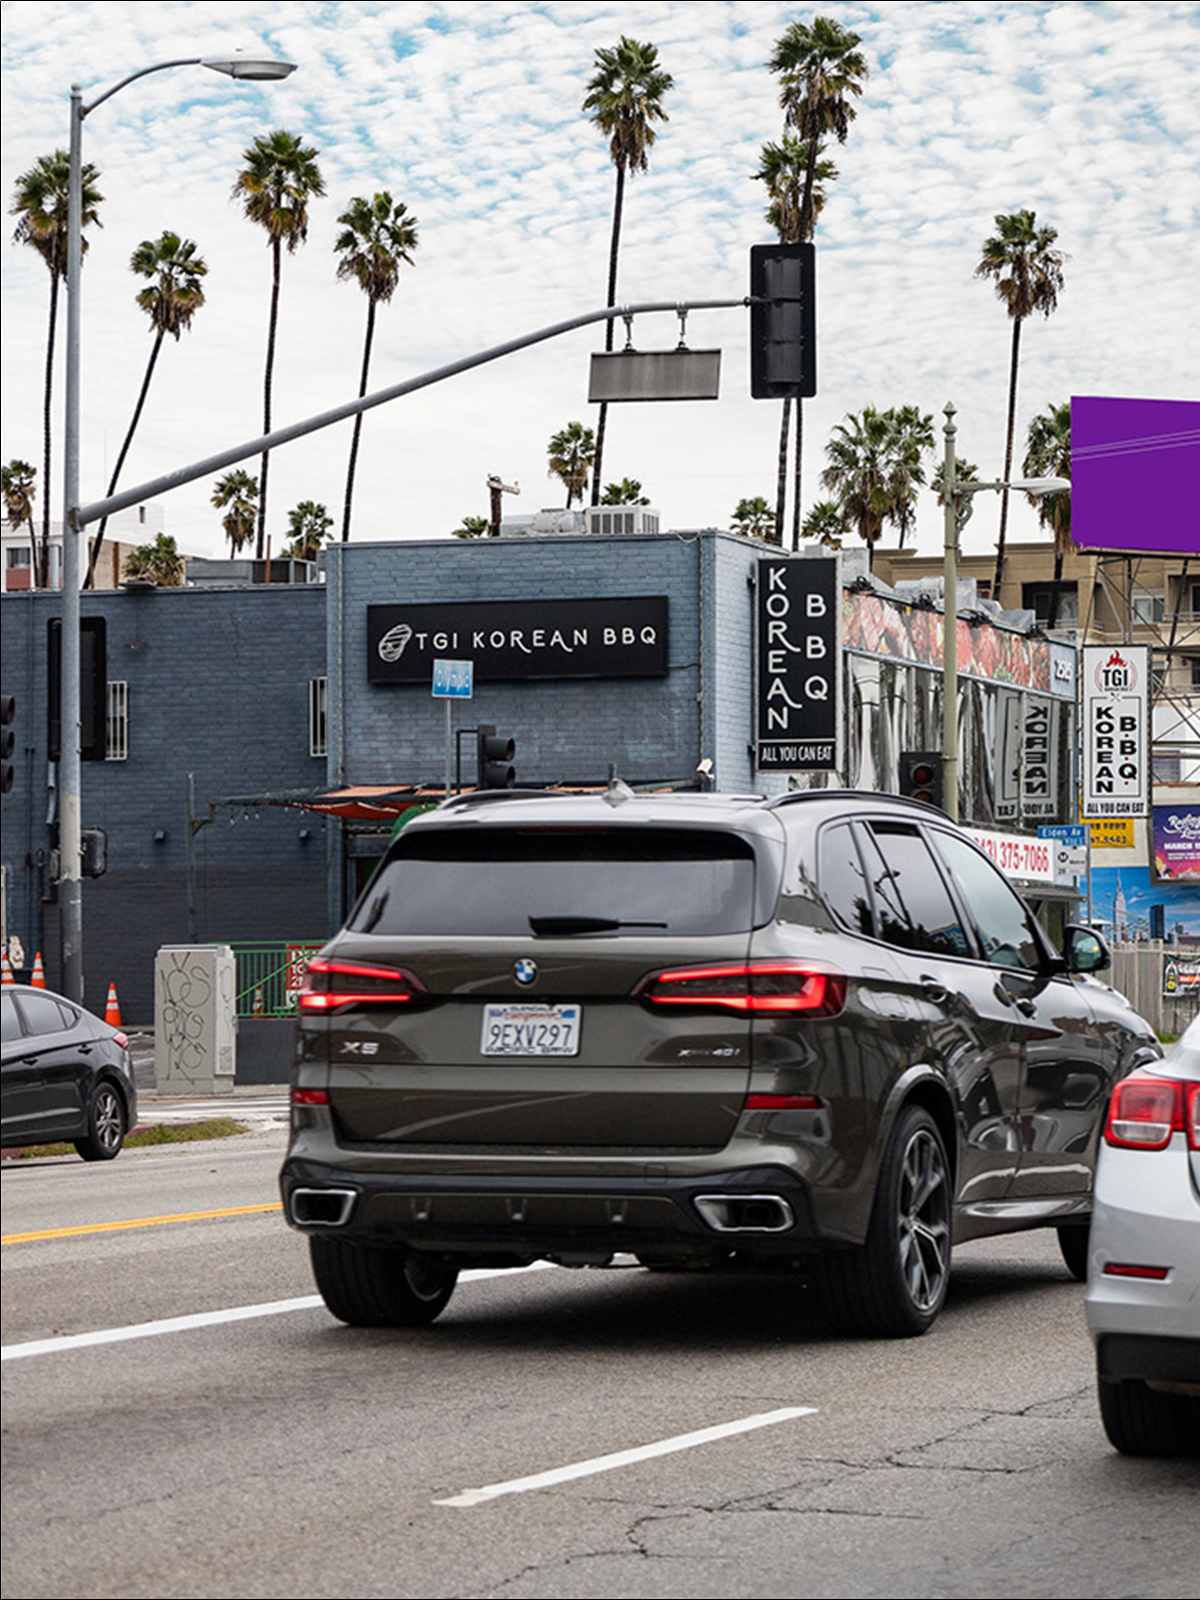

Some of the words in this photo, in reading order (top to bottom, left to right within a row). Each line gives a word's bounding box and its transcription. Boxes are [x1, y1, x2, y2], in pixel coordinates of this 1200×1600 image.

[416, 631, 459, 652] TGI
[473, 628, 588, 654] KOREAN
[604, 626, 657, 646] BBQ
[766, 567, 802, 730] KOREAN
[804, 594, 828, 701] BBQ
[1102, 668, 1129, 687] TGI
[761, 748, 777, 762] ALL
[779, 747, 797, 762] YOU
[798, 746, 816, 761] CAN
[817, 745, 832, 760] EAT
[1095, 706, 1115, 794] KOREAN
[1087, 803, 1099, 814] ALL
[1100, 803, 1115, 814] YOU
[1116, 803, 1131, 814] CAN
[1132, 803, 1145, 814] EAT
[1042, 829, 1067, 838] Elden
[1000, 842, 1050, 873] 375-7066
[490, 1024, 572, 1047] 9EXV297
[339, 1040, 379, 1055] X5
